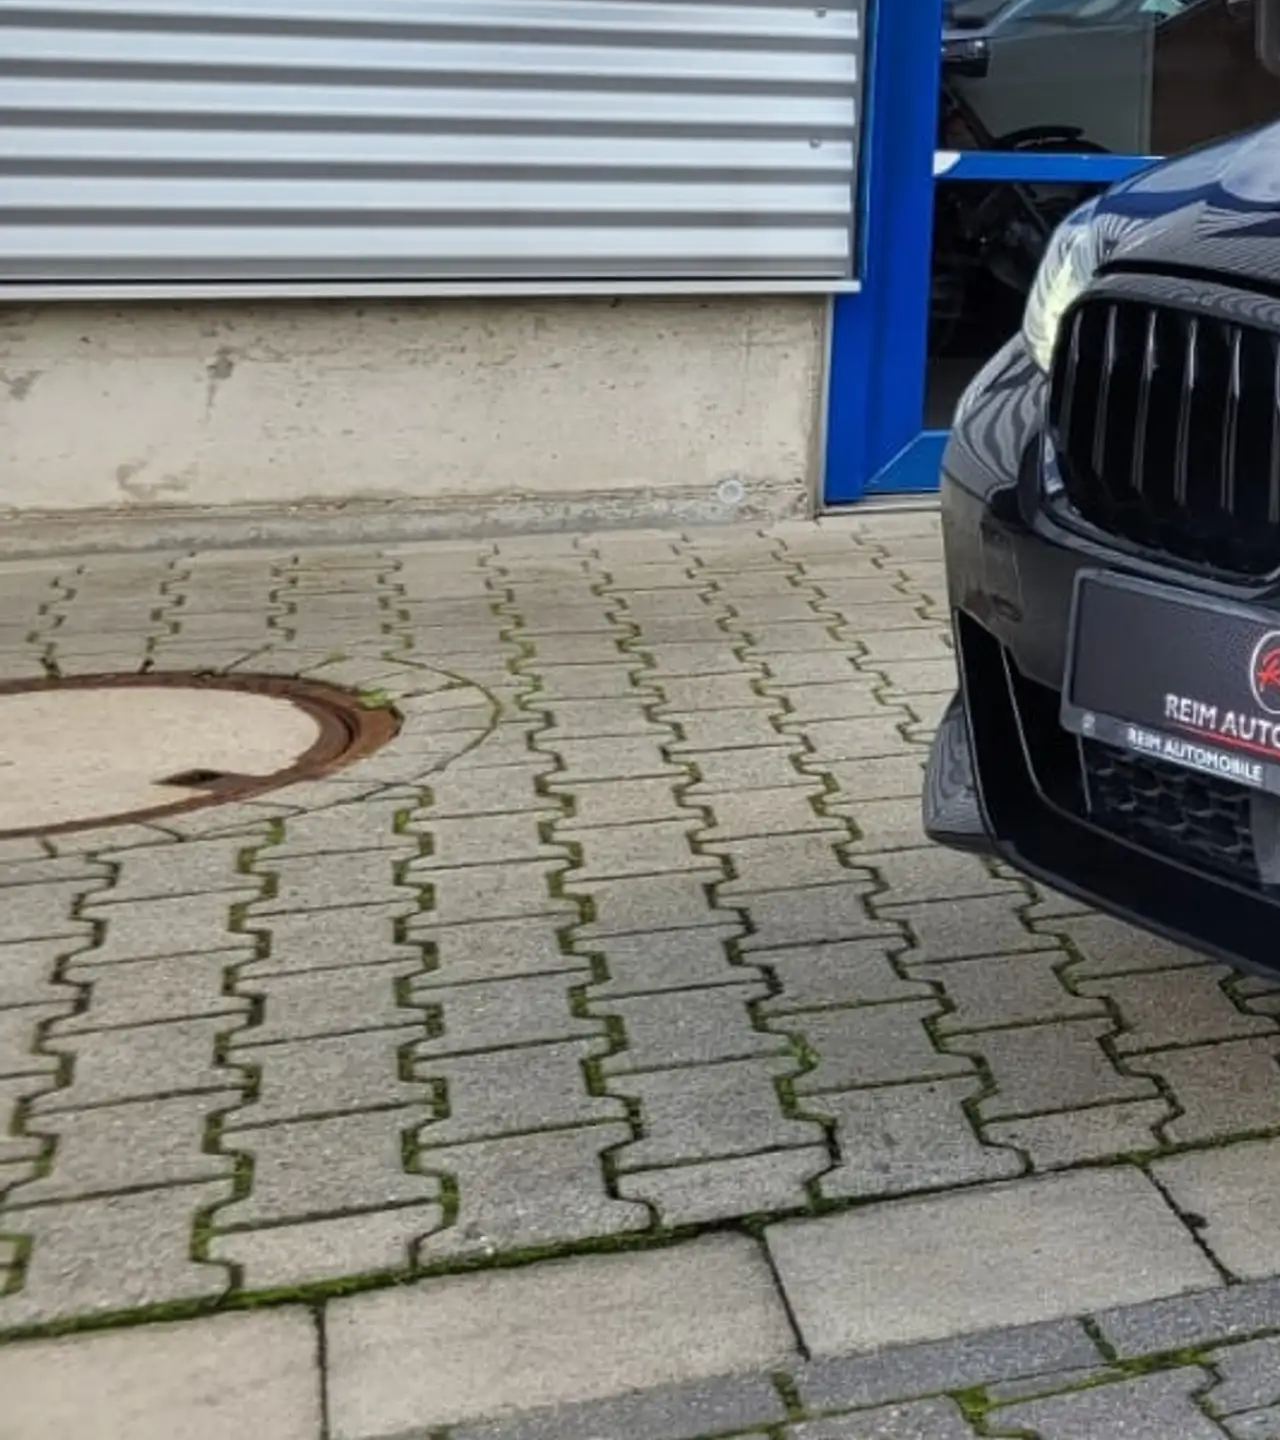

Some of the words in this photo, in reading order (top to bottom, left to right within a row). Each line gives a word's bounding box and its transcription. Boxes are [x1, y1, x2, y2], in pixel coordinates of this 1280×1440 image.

[1164, 692, 1217, 729] REIM
[1127, 727, 1161, 751] REIM
[1163, 738, 1263, 781] AUTOMOBILE
